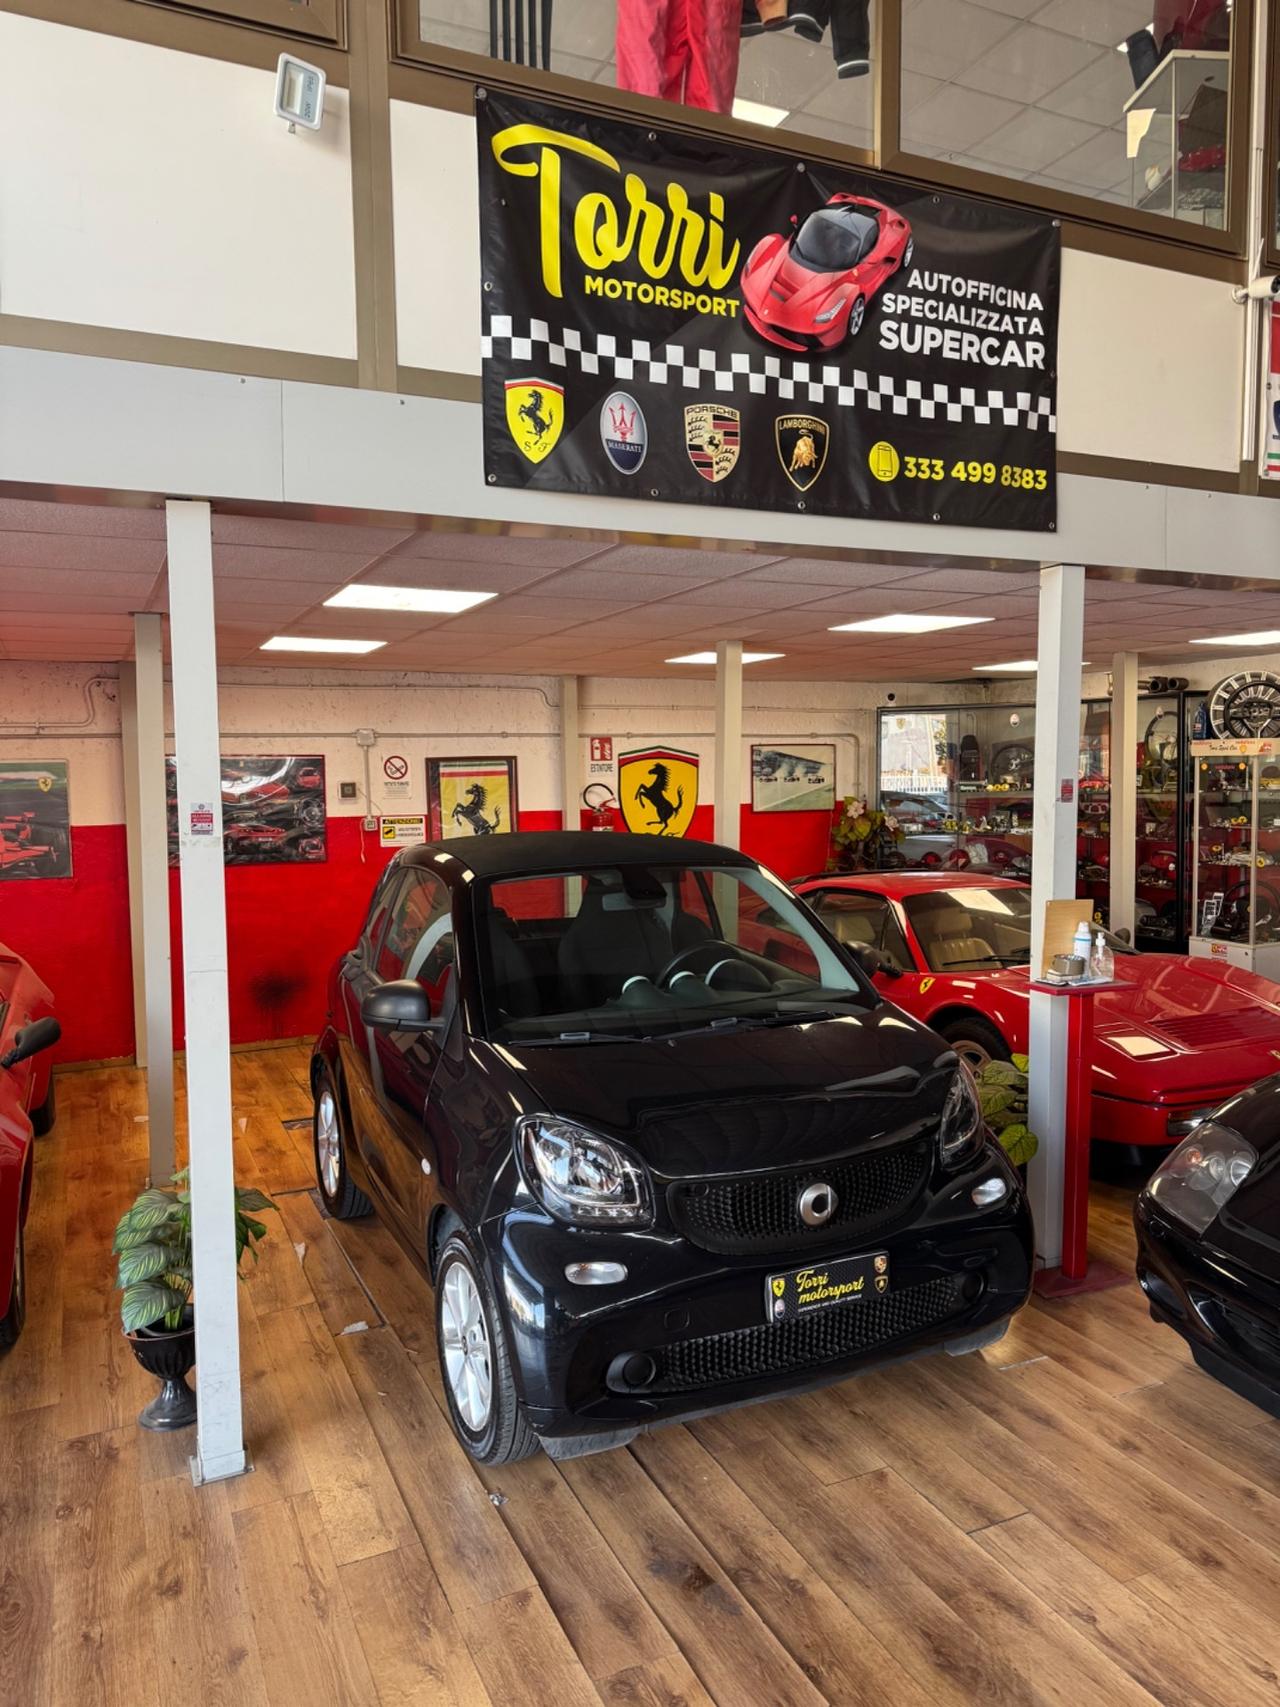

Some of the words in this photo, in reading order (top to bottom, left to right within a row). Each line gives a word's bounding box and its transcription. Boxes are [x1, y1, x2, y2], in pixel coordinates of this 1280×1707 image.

[491, 124, 741, 298] Torri
[584, 274, 740, 318] MOTORSPORT
[907, 268, 1044, 311] AUTOFFICINA
[881, 292, 1045, 336] SPECIALIZZATA
[879, 319, 1046, 370] SUPERCAR
[686, 405, 738, 418] PORSCHE
[607, 440, 642, 453] MASERATI
[903, 455, 945, 481] 333
[951, 460, 997, 484] 499
[1000, 464, 1048, 491] 8383
[796, 1269, 829, 1292] Torri
[798, 1276, 865, 1304] motorsport
